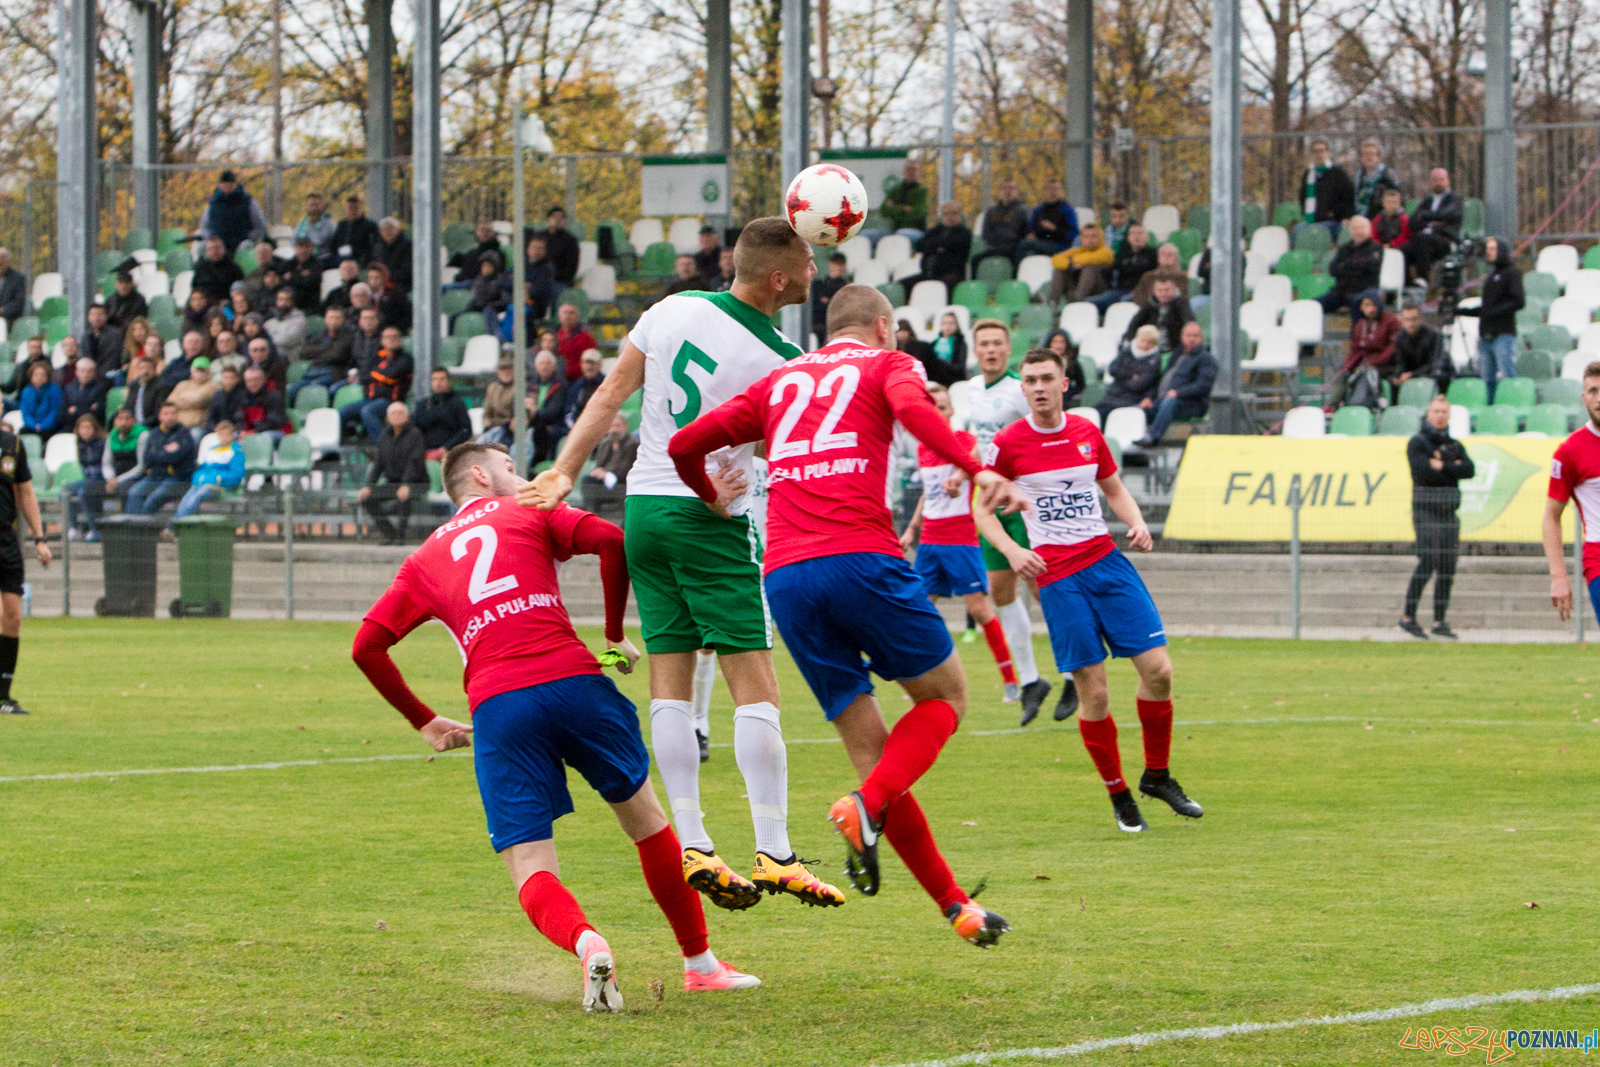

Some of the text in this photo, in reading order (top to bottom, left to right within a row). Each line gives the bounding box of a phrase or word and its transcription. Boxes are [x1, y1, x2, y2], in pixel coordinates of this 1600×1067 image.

[668, 340, 719, 430] 5
[769, 364, 861, 462] 22
[803, 457, 869, 481] PUŁAWY
[1223, 472, 1388, 507] FAMILY
[435, 500, 500, 540] ZEMŁO
[450, 524, 520, 605] 2
[495, 593, 559, 619] PUŁAWY
